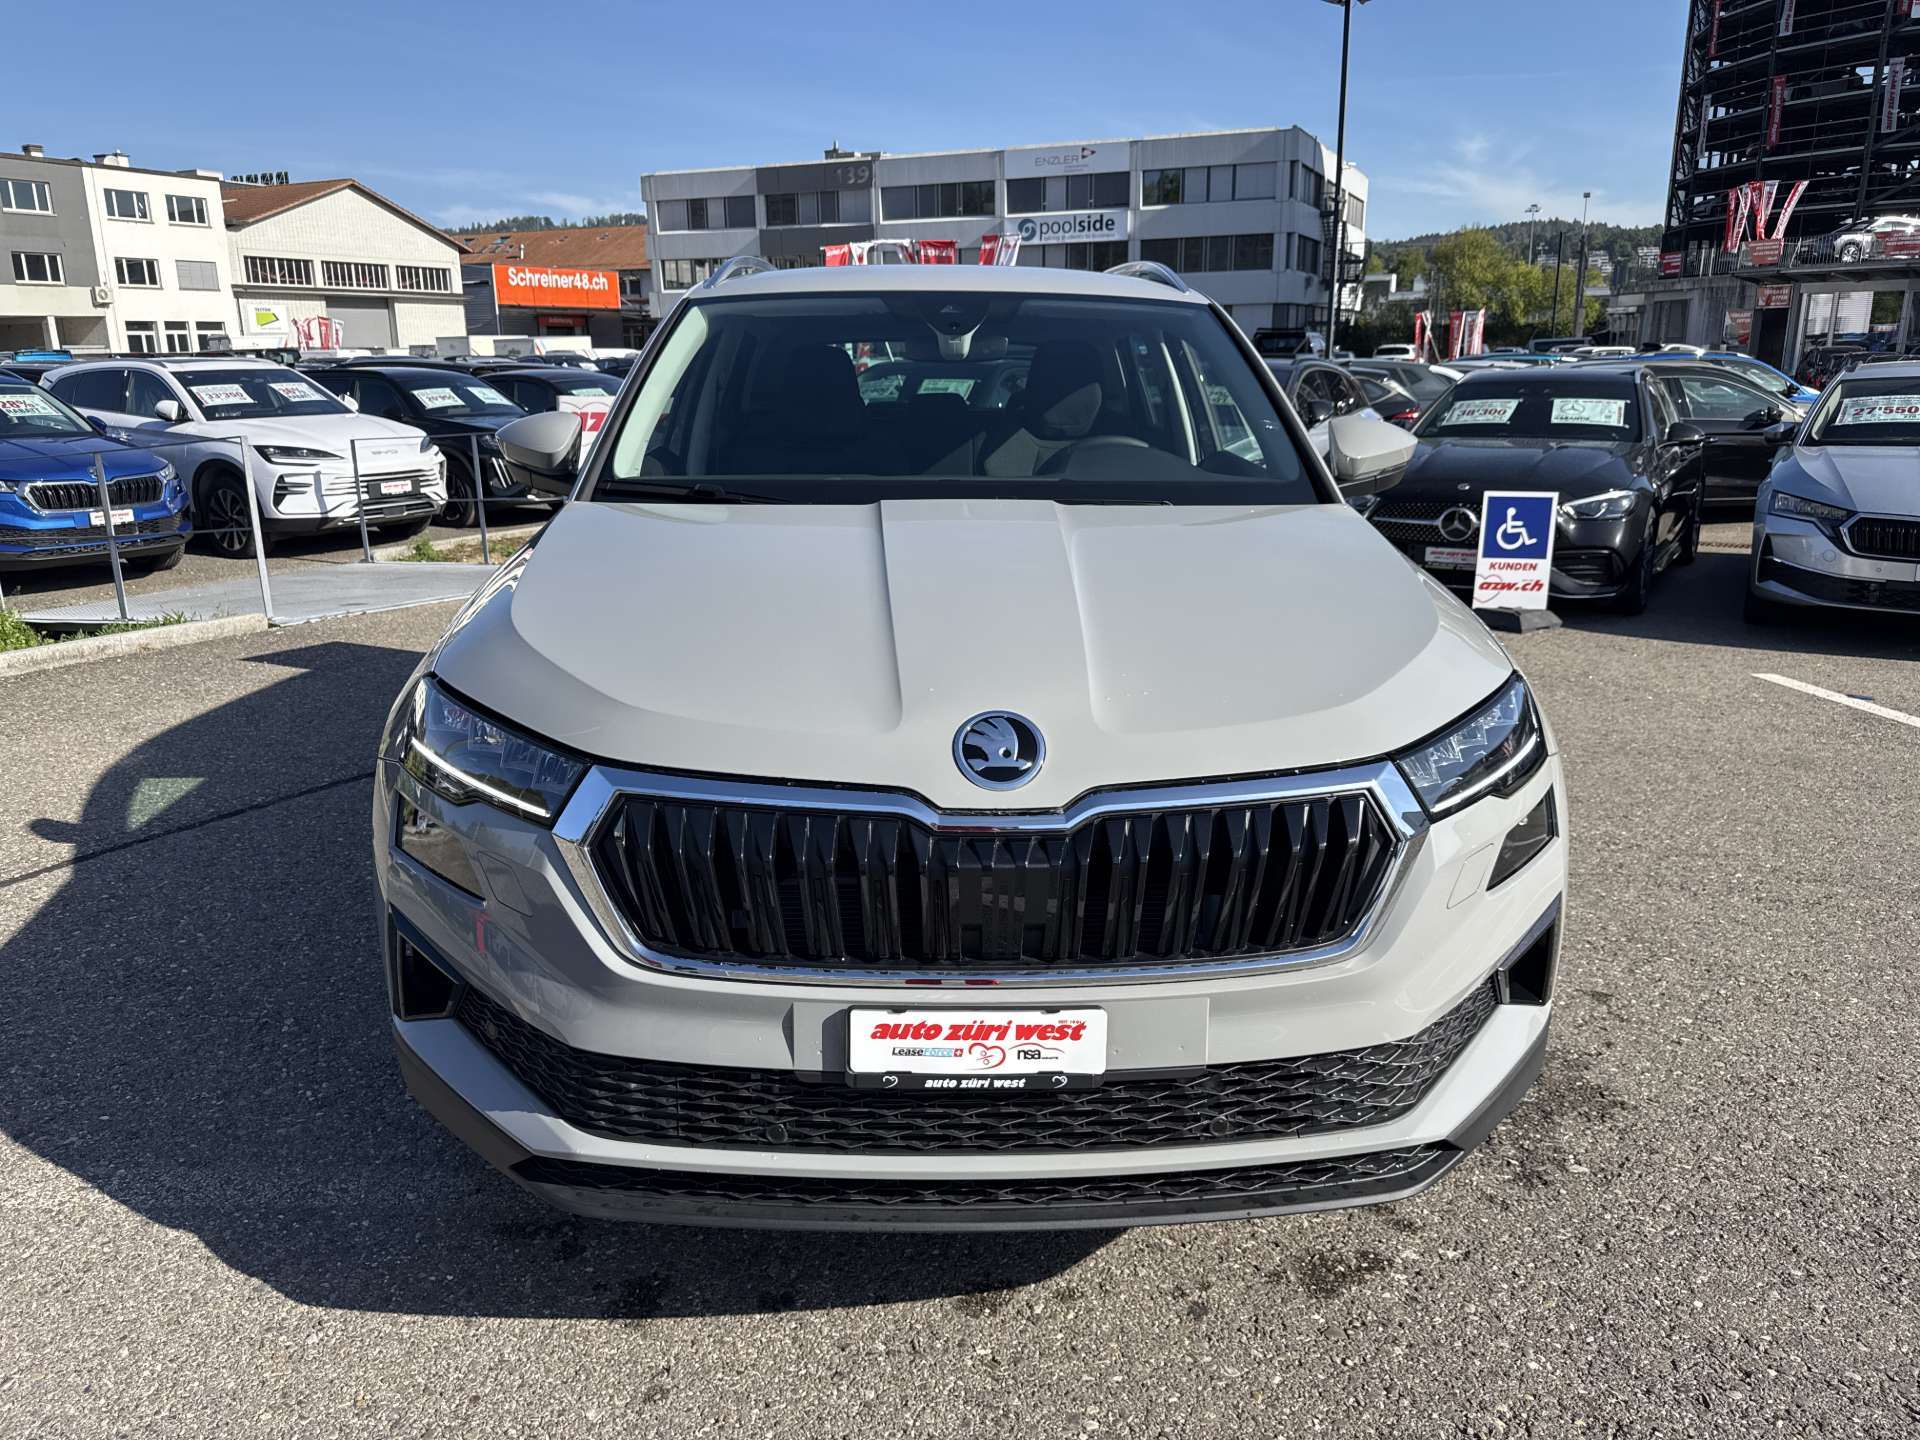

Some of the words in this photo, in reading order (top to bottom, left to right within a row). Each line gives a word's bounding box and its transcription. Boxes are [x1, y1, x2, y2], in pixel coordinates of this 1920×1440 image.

[1034, 154, 1079, 167] ENZLER
[836, 166, 870, 185] 139
[1040, 214, 1116, 241] poolside
[507, 266, 609, 291] Schreiner48.ch
[1853, 406, 1920, 417] 27'550
[1488, 562, 1538, 572] KUNDEN
[1478, 580, 1544, 592] azw.ch
[870, 1020, 943, 1041] auto
[943, 1019, 1013, 1041] züri
[1015, 1021, 1087, 1041] west
[892, 1047, 953, 1058] LeaseForce
[1017, 1049, 1042, 1060] nsa
[924, 1078, 958, 1088] auto
[959, 1078, 991, 1088] züri
[993, 1078, 1026, 1088] west
